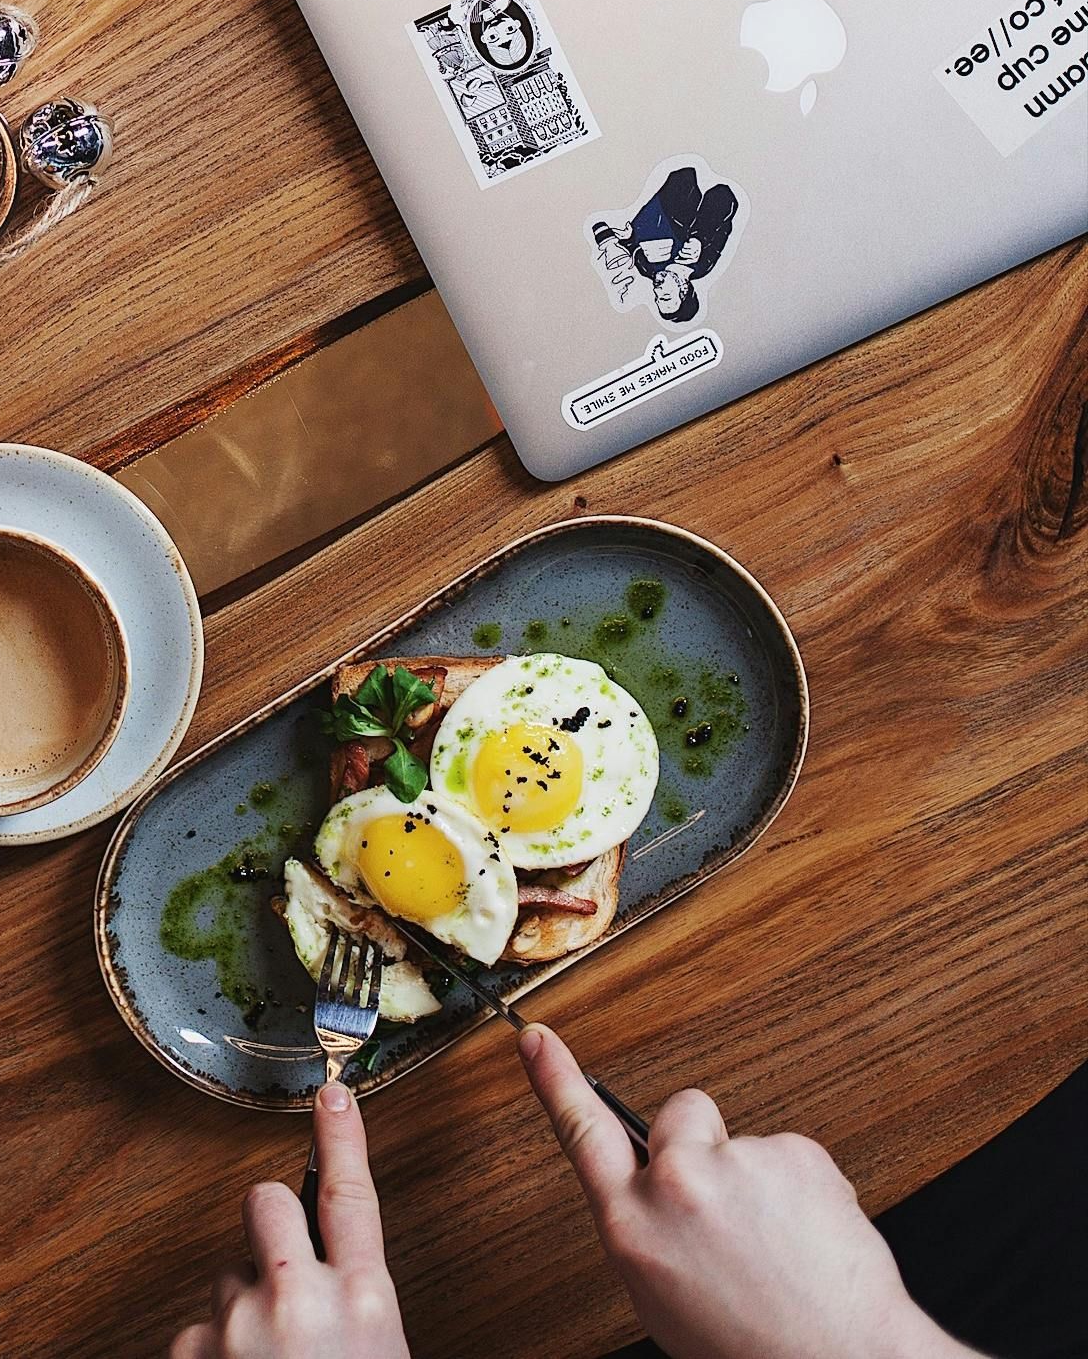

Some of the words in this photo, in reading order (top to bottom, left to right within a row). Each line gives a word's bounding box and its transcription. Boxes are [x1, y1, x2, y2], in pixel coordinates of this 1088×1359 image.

[997, 44, 1050, 91] cup
[679, 345, 710, 366] FOOD
[638, 361, 677, 388] MAKES
[618, 382, 637, 397] ME
[579, 391, 617, 415] SMILE.
